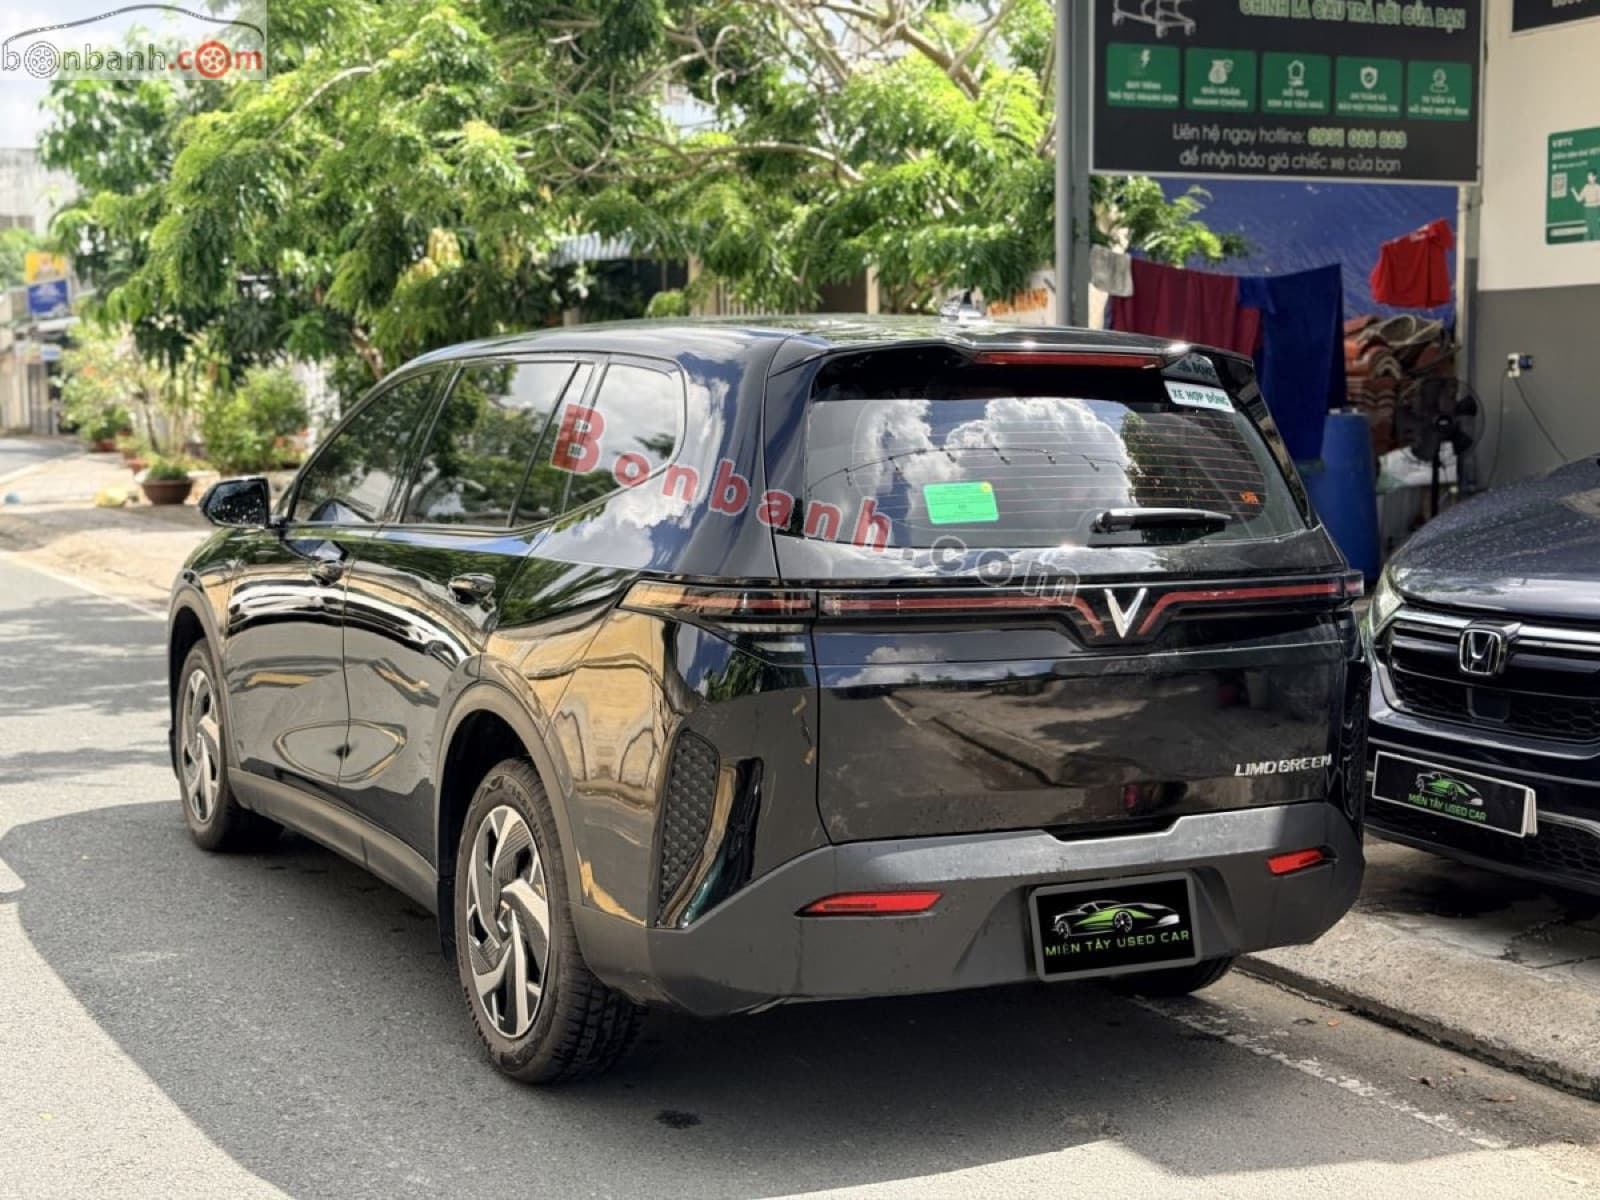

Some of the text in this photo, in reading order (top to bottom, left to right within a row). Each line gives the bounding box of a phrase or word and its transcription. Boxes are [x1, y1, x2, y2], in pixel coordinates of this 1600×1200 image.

[1173, 122, 1199, 140] Liên
[1202, 124, 1220, 143] hệ
[1223, 128, 1257, 146] ngay
[1179, 145, 1199, 166] để
[1201, 150, 1236, 169] nhận
[1347, 153, 1373, 171] của
[1375, 156, 1401, 174] bạn
[1234, 753, 1332, 777] LIMO GREEN
[1445, 803, 1468, 817] USED
[1468, 809, 1487, 821] CAR
[1117, 933, 1155, 949] USED
[1160, 929, 1190, 943] CAR
